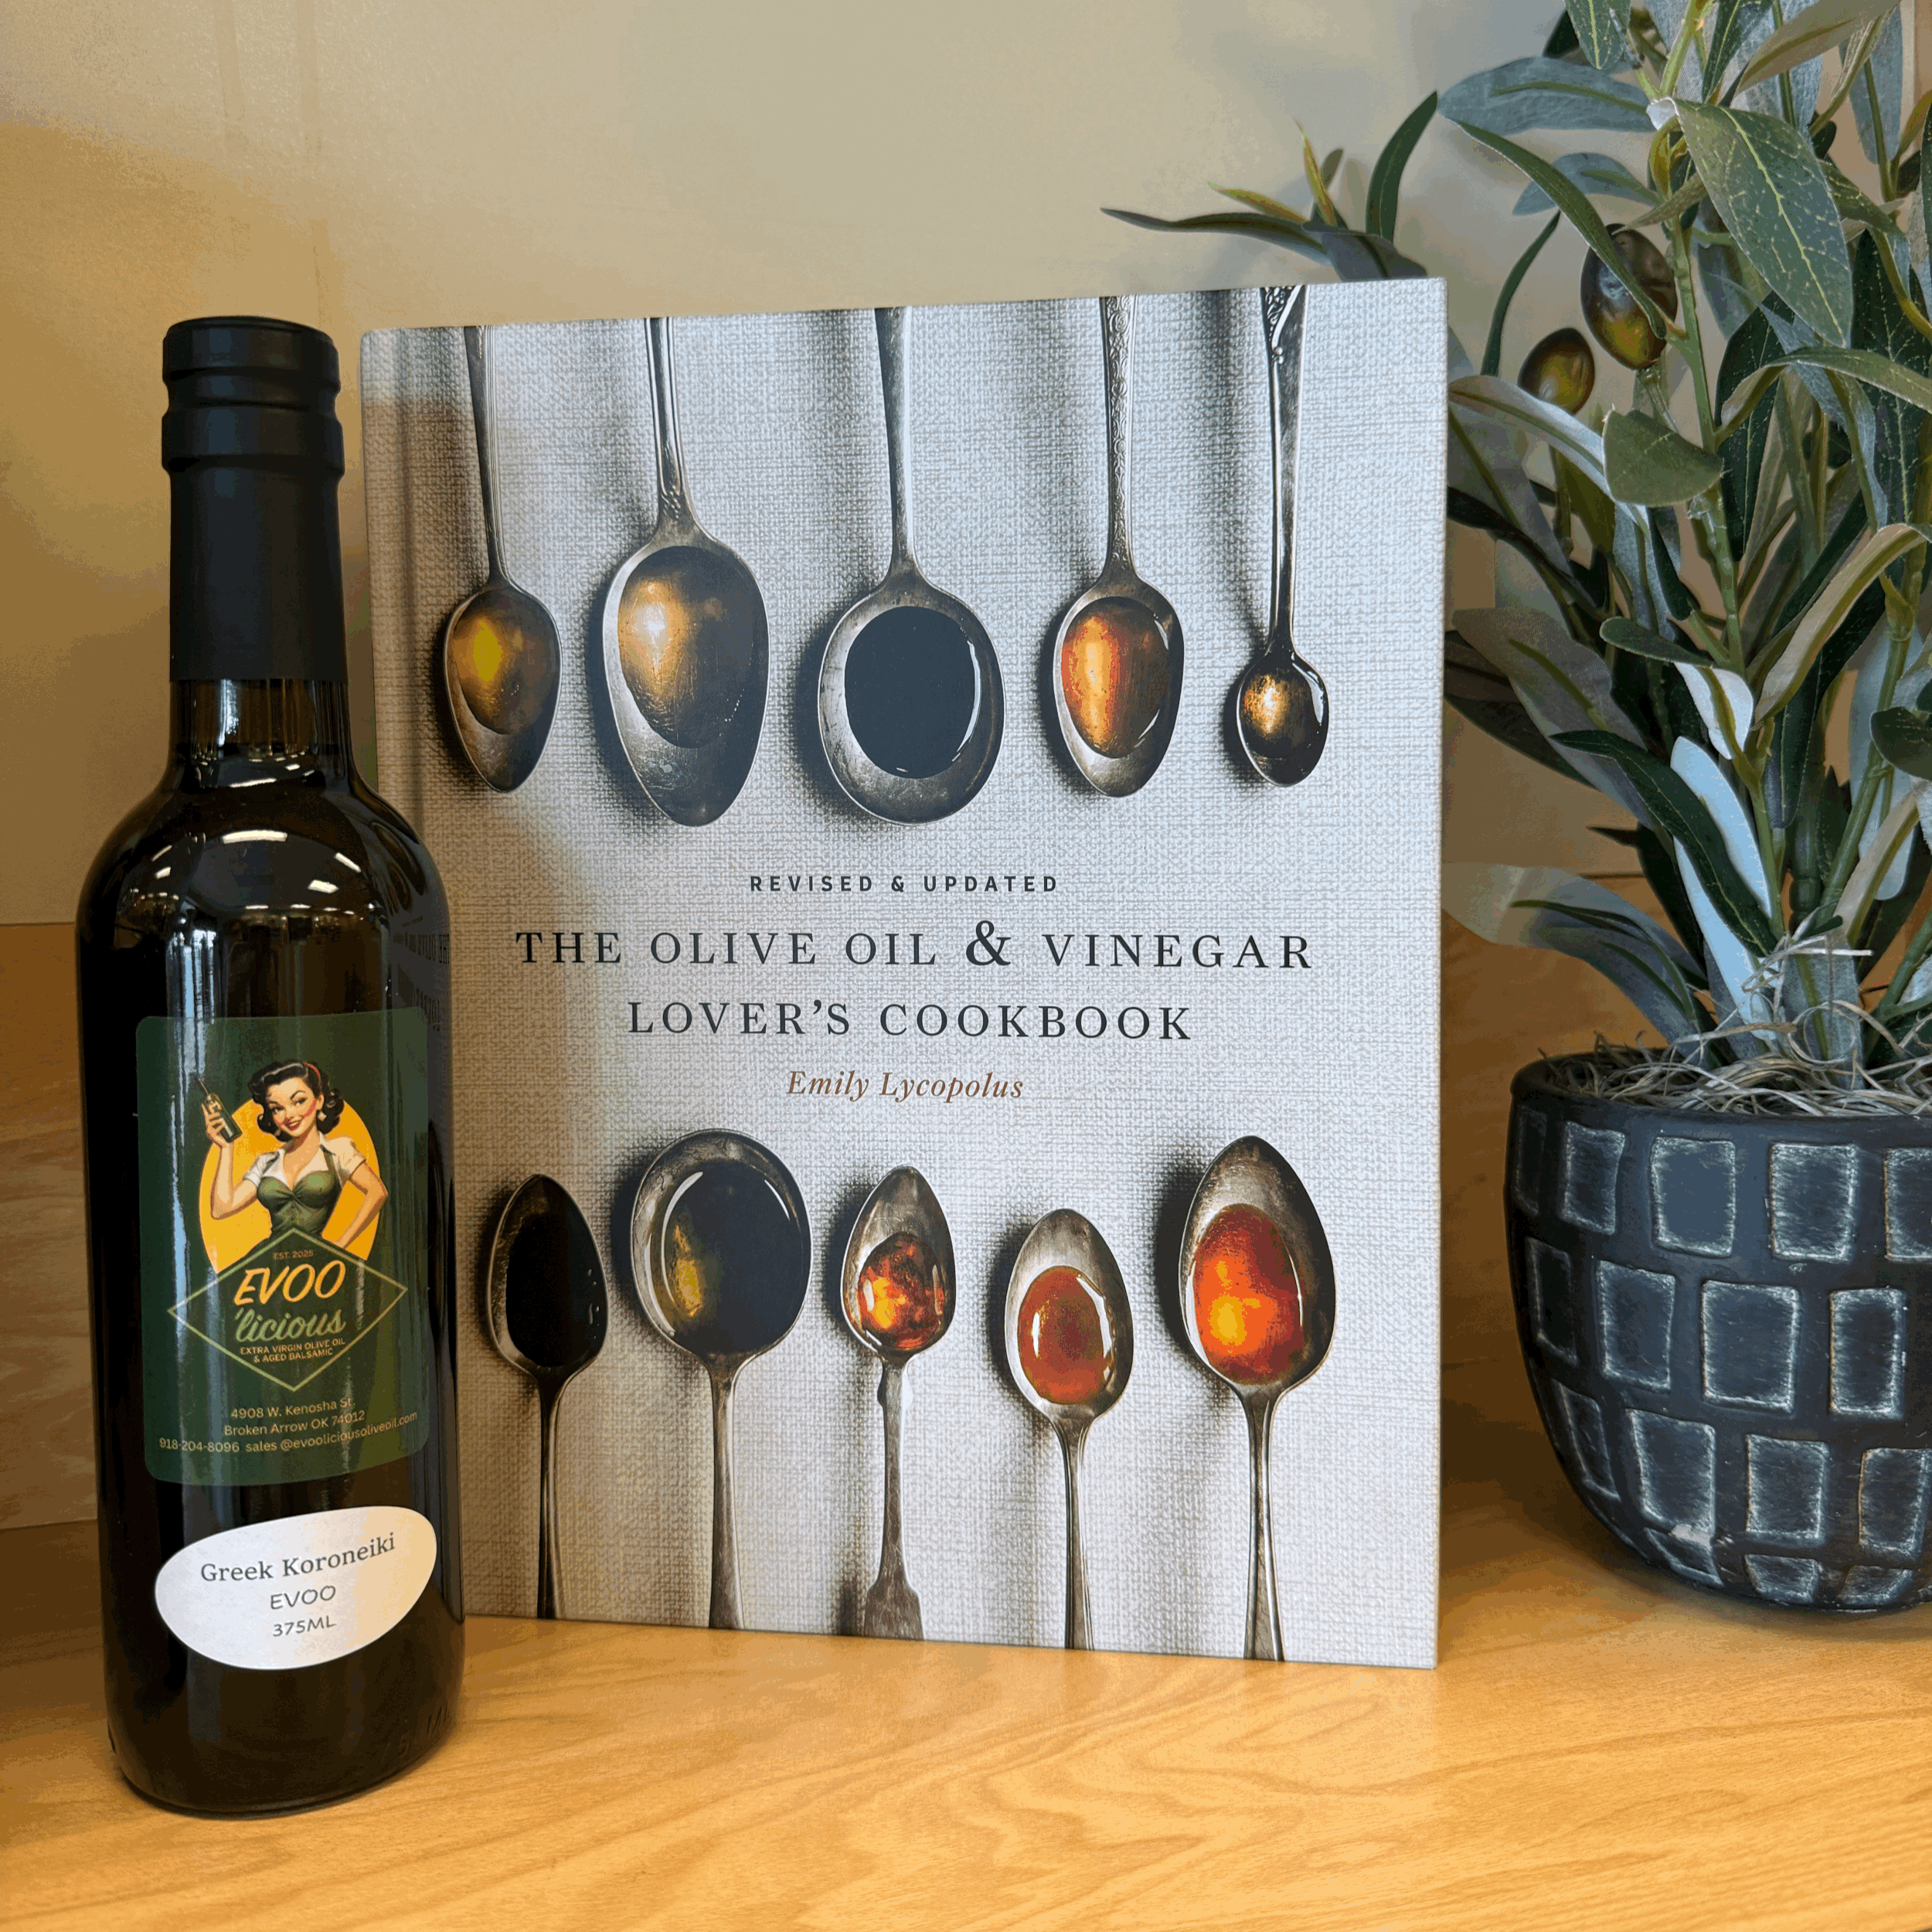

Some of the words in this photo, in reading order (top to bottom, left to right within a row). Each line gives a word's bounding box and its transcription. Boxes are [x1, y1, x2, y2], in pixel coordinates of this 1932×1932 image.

[750, 875, 873, 892] REVISED
[891, 875, 904, 893] &
[923, 876, 1057, 893] UPDATED
[515, 932, 621, 964] THE
[650, 932, 816, 965] OLIVE
[845, 932, 937, 966] OIL
[965, 920, 1012, 966] &
[1042, 933, 1312, 969] VINEGAR
[628, 999, 850, 1036] LOVER’S
[879, 1003, 1191, 1040] COOKBOOK
[787, 1070, 869, 1102] Emily
[879, 1071, 1024, 1104] Lycopolus
[273, 1252, 291, 1260] EST.
[292, 1250, 314, 1259] 2025
[233, 1259, 346, 1306] EVOO
[235, 1307, 347, 1342] 'licious
[240, 1345, 270, 1355] EXTRA
[272, 1343, 303, 1353] VIRGIN
[304, 1339, 331, 1350] OLIVE
[332, 1338, 346, 1346] OIL
[253, 1355, 260, 1363] &
[262, 1353, 287, 1363] AGED
[288, 1347, 333, 1360] BALSAMIC
[230, 1406, 264, 1420] 4908
[267, 1406, 283, 1418] W.
[285, 1400, 338, 1417] Kenosha
[339, 1396, 356, 1409] St.
[158, 1437, 240, 1453] 918-204-8096
[245, 1440, 277, 1453] sales
[280, 1411, 418, 1452] @evooliciousoliveoil.com
[223, 1424, 268, 1437] Broken
[270, 1421, 308, 1434] Arrow
[310, 1417, 329, 1430] OK
[332, 1410, 366, 1426] 74012
[200, 1560, 274, 1582] Greek
[282, 1532, 396, 1578] Koroneiki
[270, 1585, 337, 1610] EVOO
[272, 1615, 336, 1637] 375ML
